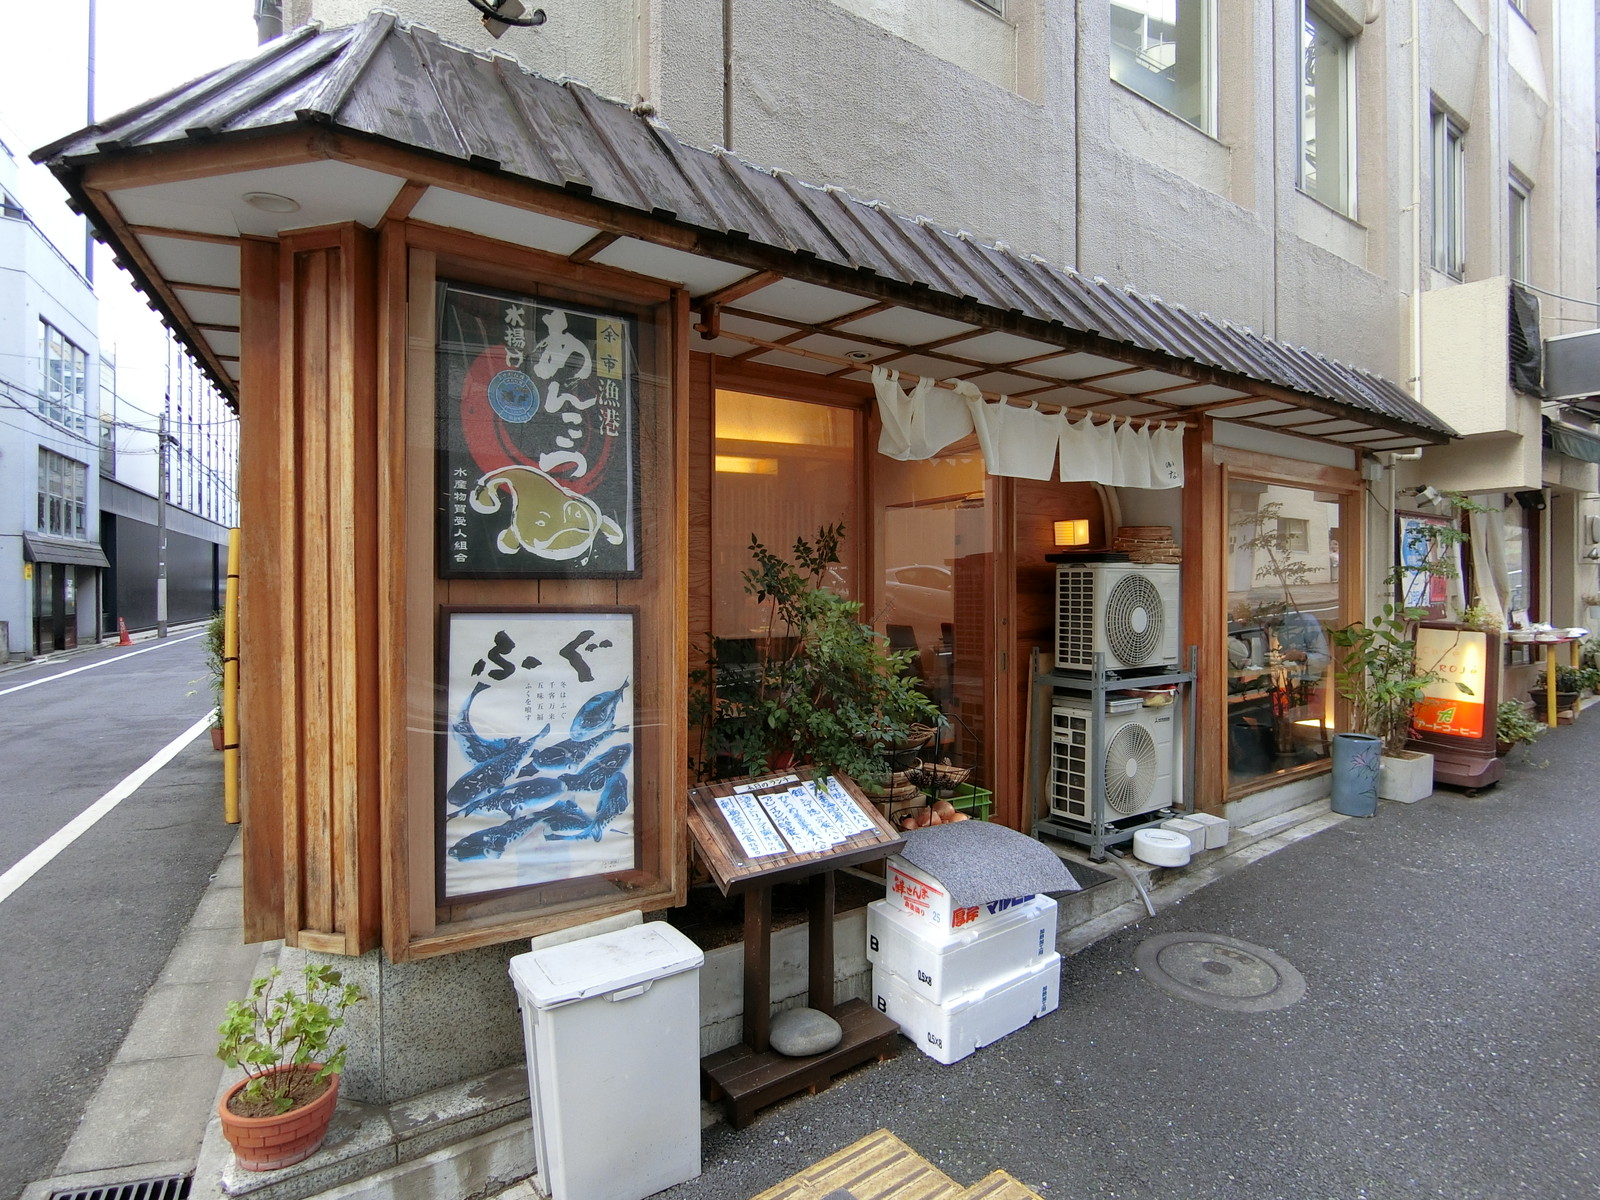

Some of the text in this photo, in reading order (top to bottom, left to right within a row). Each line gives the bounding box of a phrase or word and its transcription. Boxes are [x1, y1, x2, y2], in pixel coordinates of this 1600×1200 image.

[534, 310, 597, 479] あんこう
[600, 324, 621, 437] 余市漁港
[453, 467, 468, 563] 水産物買受人組合
[471, 629, 613, 683] ふぐ
[1416, 719, 1479, 736] アートコーヒー
[932, 910, 941, 923] 25
[870, 934, 879, 952] B
[877, 995, 887, 1013] B
